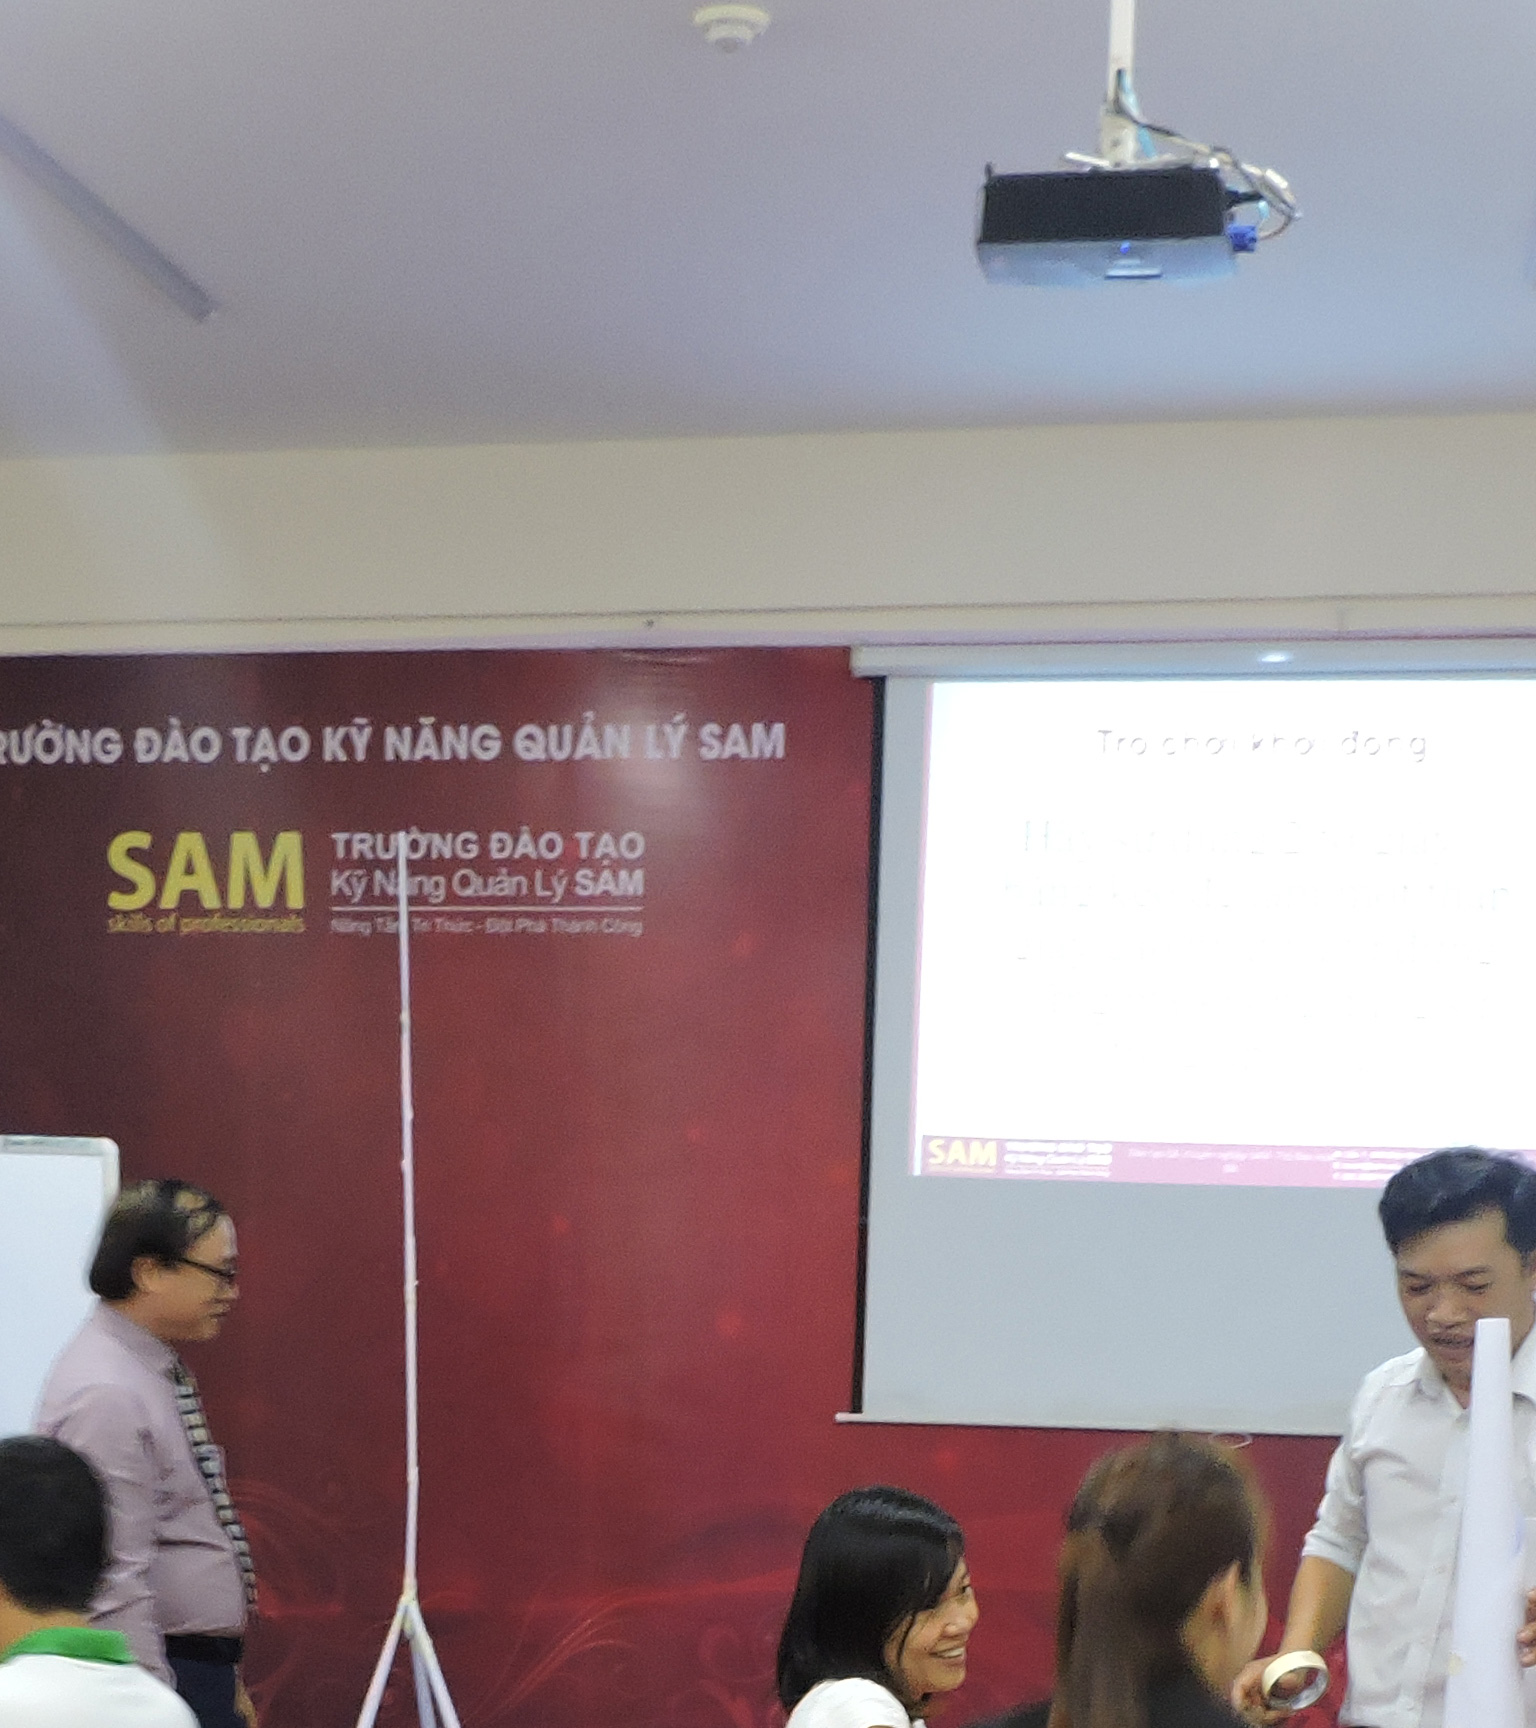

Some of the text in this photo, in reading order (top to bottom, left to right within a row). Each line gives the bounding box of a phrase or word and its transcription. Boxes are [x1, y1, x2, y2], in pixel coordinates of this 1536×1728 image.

[133, 716, 223, 763] ĐÀO
[230, 725, 312, 773] TẠO
[322, 717, 373, 762] KỸ
[383, 716, 502, 762] NĂNG
[512, 711, 632, 762] QUẢN
[642, 711, 687, 760] LÝ
[698, 721, 787, 761] SAM
[489, 825, 564, 860] ĐÀO
[107, 830, 307, 911] SAM
[574, 867, 646, 897] SAM
[927, 1139, 997, 1167] SAM
